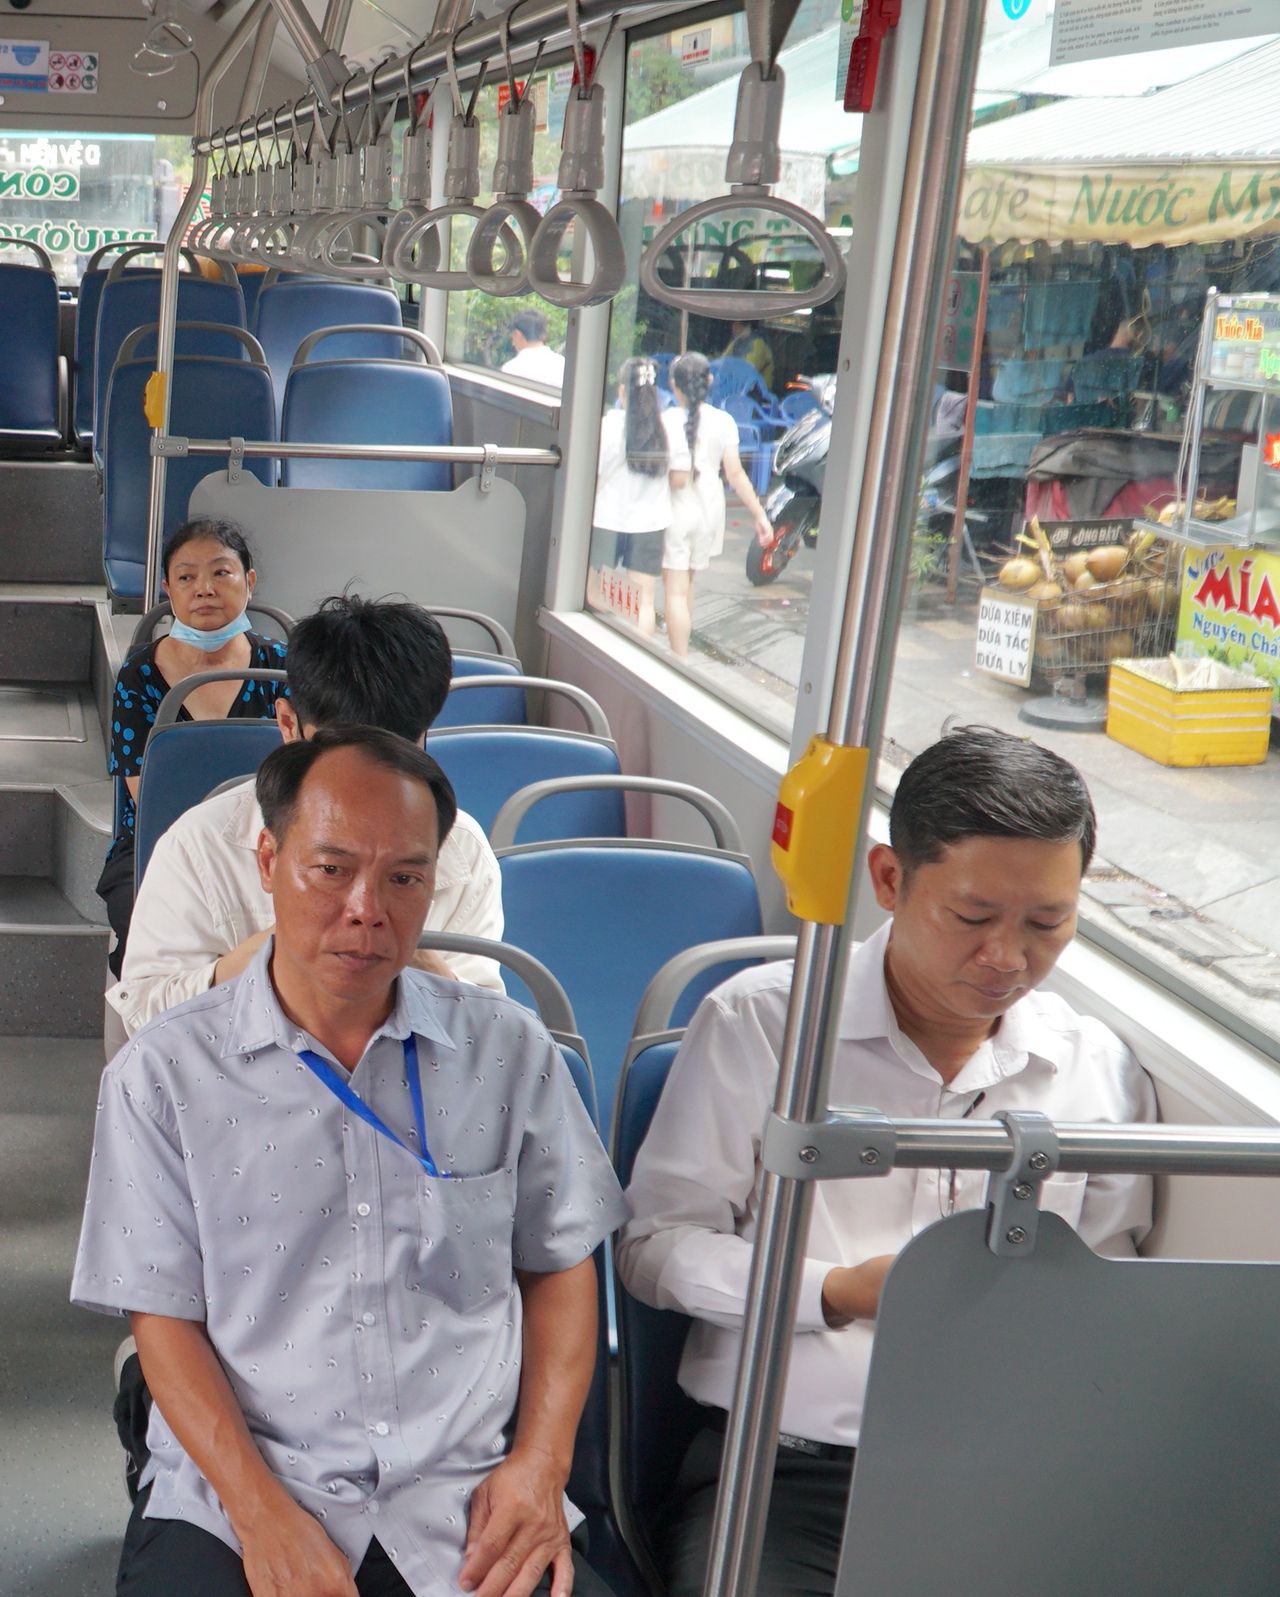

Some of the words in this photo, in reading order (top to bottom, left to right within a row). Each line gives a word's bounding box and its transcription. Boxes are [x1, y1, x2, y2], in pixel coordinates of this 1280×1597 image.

[1068, 171, 1195, 227] Nước
[1194, 559, 1280, 630] MÍA
[1192, 611, 1246, 647] Nguyên
